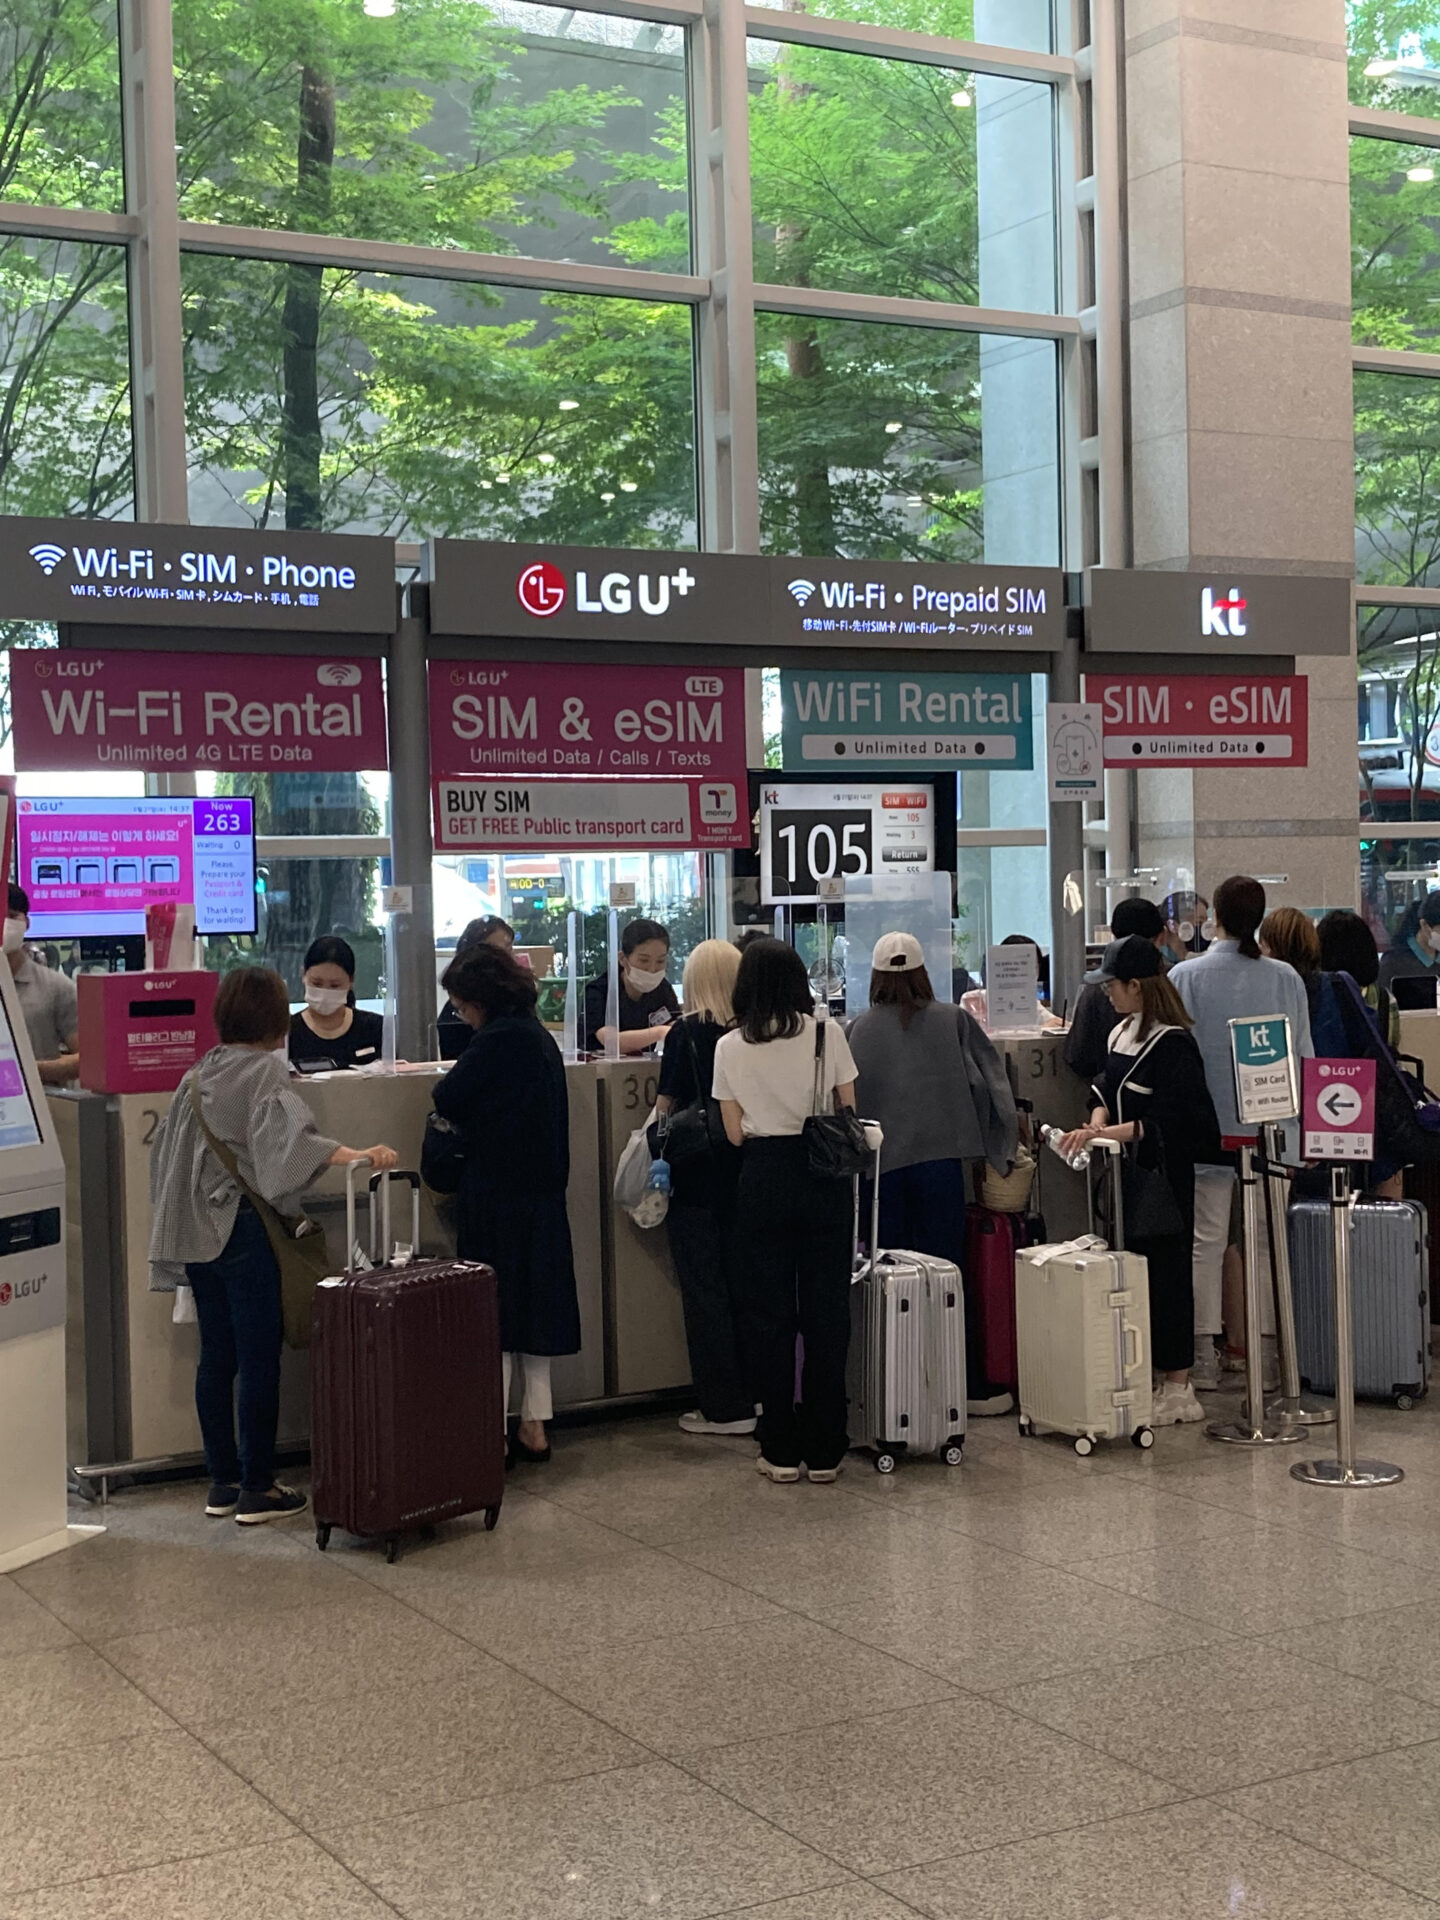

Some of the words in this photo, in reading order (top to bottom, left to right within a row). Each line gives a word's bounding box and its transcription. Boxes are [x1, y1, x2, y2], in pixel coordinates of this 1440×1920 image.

[72, 547, 154, 580] Wi-Fi
[180, 552, 237, 583] SIM
[262, 556, 356, 590] Phone
[820, 581, 886, 609] Wi-Fi
[912, 584, 999, 617] Prepaid
[1005, 587, 1046, 614] SIM
[1202, 587, 1247, 636] kt
[691, 680, 718, 694] LTE
[793, 682, 882, 722] WiFi
[900, 683, 1022, 723] Rental
[1103, 686, 1169, 724] SIM
[1209, 687, 1292, 724] eSIM
[42, 689, 182, 735] Wi-Fi
[205, 692, 362, 737] Rental
[452, 695, 537, 740] SIM
[559, 698, 593, 742] &
[614, 701, 723, 743] eSIM
[98, 743, 187, 762] Unlimited
[195, 745, 221, 762] 4G
[229, 745, 263, 762] LTE
[271, 746, 312, 762] Data
[470, 748, 547, 765] Unlimited
[554, 750, 591, 766] Data
[610, 751, 649, 766] Calls
[668, 751, 711, 767] Texts
[854, 742, 927, 755] Unlimited
[935, 743, 967, 755] Data
[1149, 741, 1213, 755] Unlimited
[1220, 741, 1249, 754] Data
[211, 801, 233, 811] Now
[447, 791, 487, 812] BUY
[494, 791, 530, 812] SIM
[764, 790, 779, 804] kt
[885, 797, 900, 805] SIM
[204, 814, 241, 832] 263
[705, 810, 732, 818] money
[907, 813, 920, 822] 105
[449, 818, 478, 835] GET
[482, 818, 520, 835] FREE
[524, 818, 571, 835] Public
[575, 819, 646, 838] transport
[652, 818, 684, 834] card
[234, 841, 240, 850] 0
[778, 824, 868, 882] 105
[891, 850, 918, 859] Return
[204, 916, 214, 924] for
[206, 906, 228, 914] Thank
[230, 907, 244, 915] you
[1250, 1025, 1270, 1049] kt
[1030, 1048, 1058, 1078] 31
[1254, 1077, 1267, 1086] SIM
[1270, 1075, 1286, 1084] Card
[624, 1074, 657, 1109] 30
